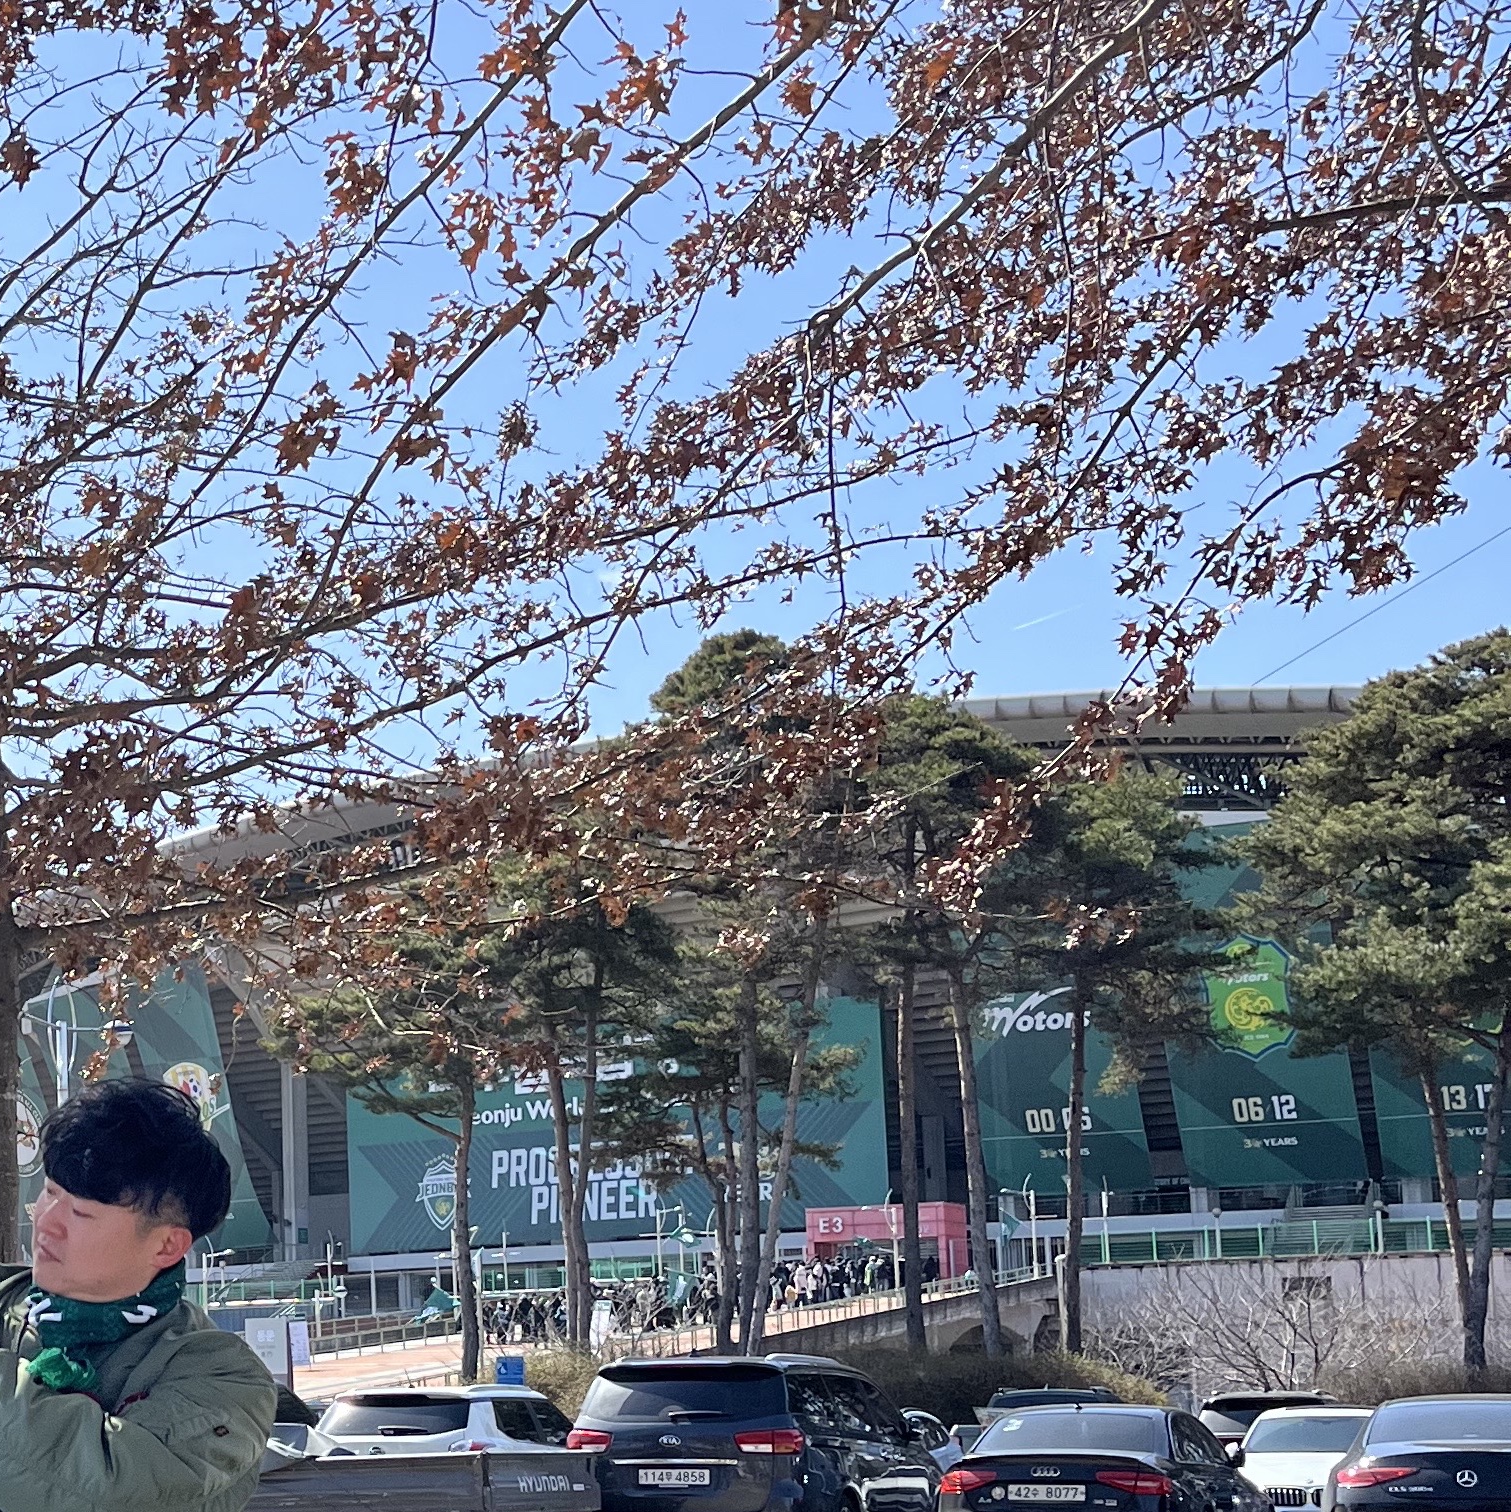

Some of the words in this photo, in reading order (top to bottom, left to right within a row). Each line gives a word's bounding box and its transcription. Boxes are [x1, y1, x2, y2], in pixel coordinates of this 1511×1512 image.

[471, 1102, 523, 1128] eonju
[1263, 1137, 1299, 1147] YEARS
[418, 1183, 456, 1196] JEONB
[531, 1179, 657, 1225] PINEER
[819, 1216, 844, 1234] E3
[517, 1475, 570, 1493] HYUNDAI
